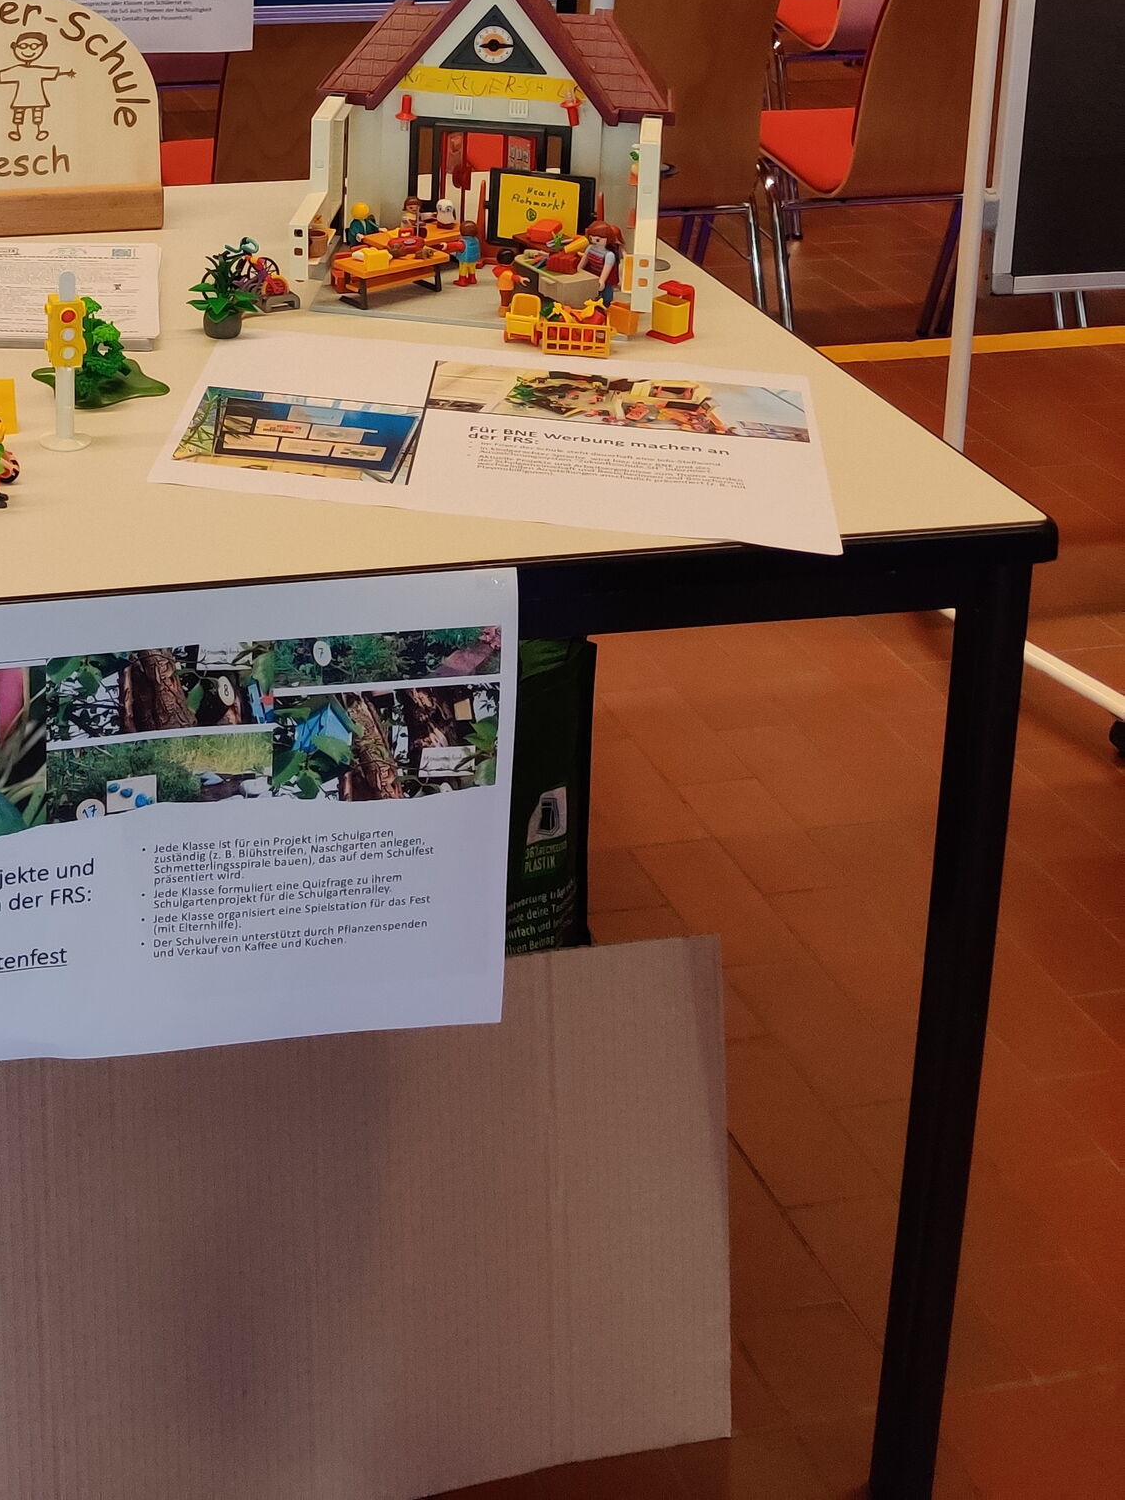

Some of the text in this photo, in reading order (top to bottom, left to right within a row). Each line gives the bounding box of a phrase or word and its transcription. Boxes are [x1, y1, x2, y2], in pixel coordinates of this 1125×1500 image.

[468, 431, 539, 445] der FRS:
[470, 425, 497, 435] Für
[504, 428, 538, 438] BNE
[544, 432, 625, 448] Werbung
[631, 441, 702, 453] machen
[82, 804, 97, 819] 17
[154, 829, 394, 853] Jede Klasse ist für ein Projekt im Schulgarten
[154, 838, 425, 863] zuständig (z. B. Blühstreifen, Naschgarten anlegen,
[55, 859, 95, 880] und
[154, 846, 434, 874] Schmetterlingsspirale bauen), das auf dem Schulfest
[8, 894, 43, 911] der
[50, 887, 92, 906] FRS:
[153, 874, 402, 899] Jede Klasse formuliert eine Quizfrage zu ihrem
[154, 884, 392, 909] Schulgartenprojekt für die Schulgartenralley.
[153, 895, 431, 923] Jede Klasse organisiert eine Spielstation für das Fest
[153, 918, 427, 947] Der Schulverein unterstützt durch Pflanzenspenden
